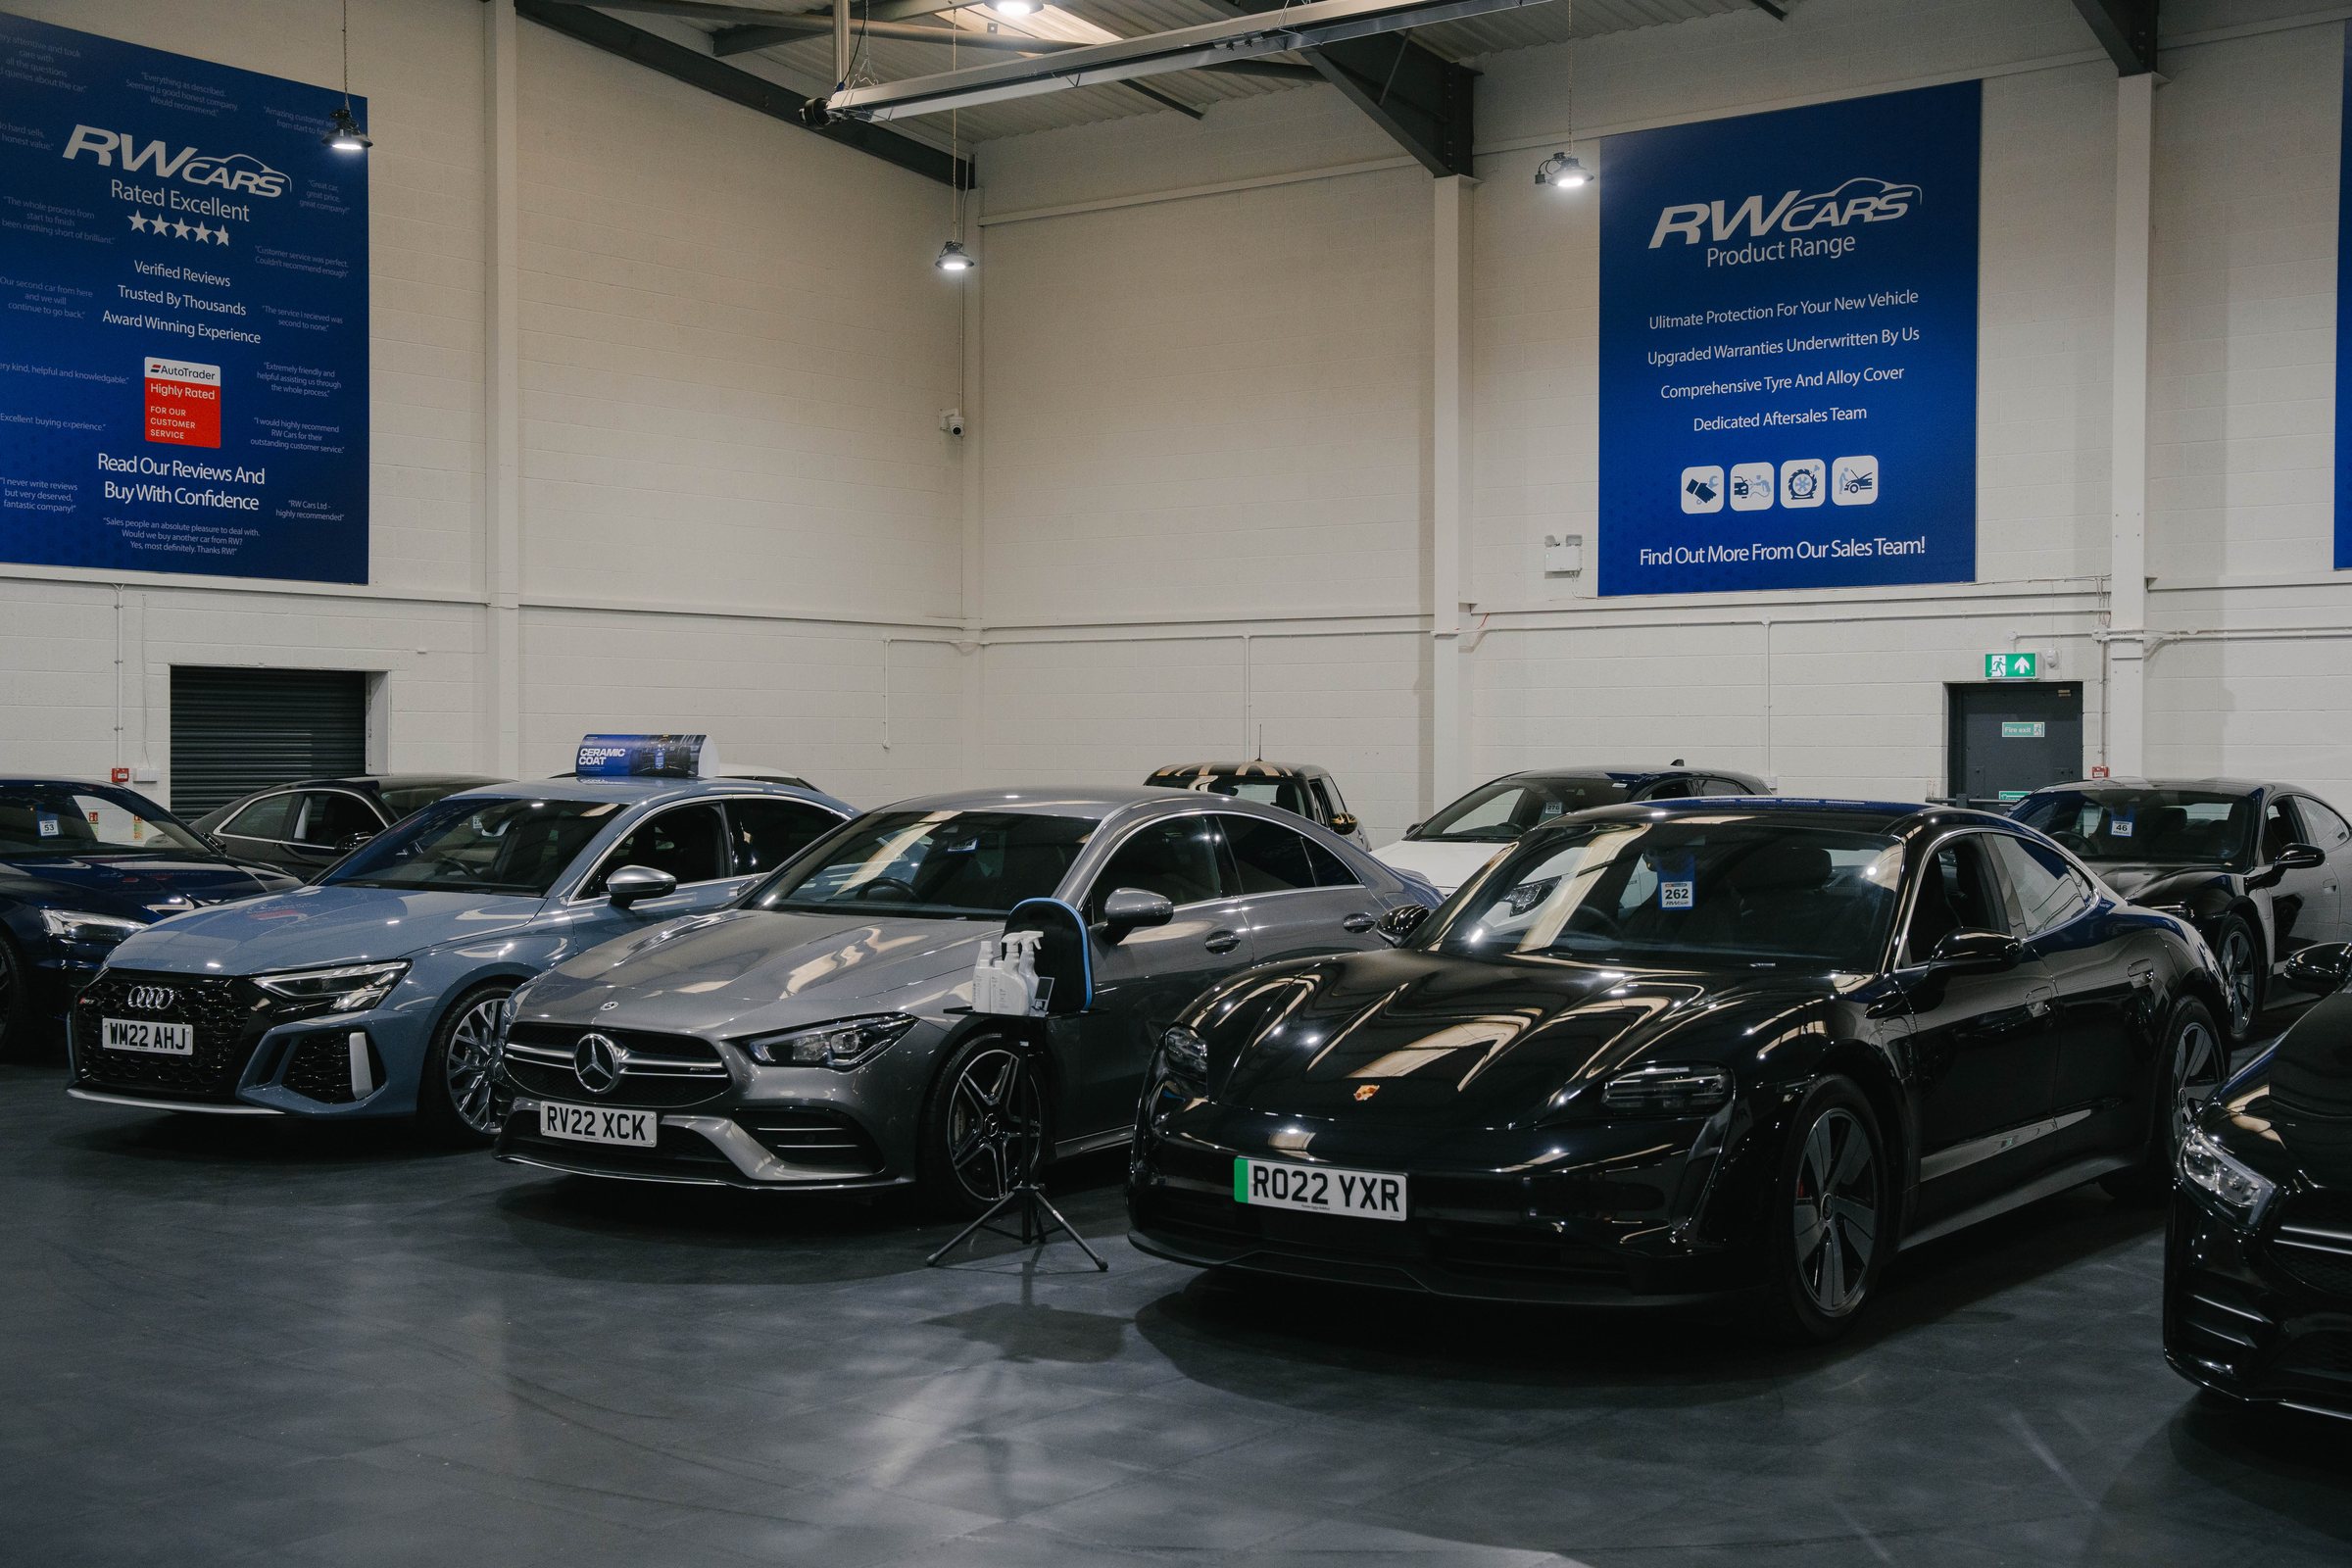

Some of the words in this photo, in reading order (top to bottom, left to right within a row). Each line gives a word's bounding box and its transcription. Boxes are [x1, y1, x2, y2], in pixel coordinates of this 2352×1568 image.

[111, 178, 166, 208] Rated
[171, 190, 250, 222] Excellent
[1707, 240, 1785, 268] Product
[1790, 235, 1856, 259] Range
[134, 260, 180, 279] Verified
[183, 269, 231, 287] Reviews
[54, 296, 67, 305] will
[118, 284, 164, 304] Trusted
[167, 291, 181, 310] By
[182, 294, 247, 317] Thousands
[8, 302, 42, 314] continue
[52, 309, 63, 318] go
[1649, 313, 1704, 329] Ulitmate
[1706, 306, 1774, 323] Protection
[1777, 303, 1799, 318] For
[1800, 300, 1832, 315] Your
[1834, 297, 1866, 311] New
[1868, 290, 1919, 308] Vehicle
[103, 310, 143, 328] Award
[144, 315, 195, 338] Winning
[198, 324, 262, 344] Experience
[1647, 344, 1712, 367] Upgraded
[1714, 340, 1783, 359] Warranties
[1786, 331, 1878, 352] Underwritten
[1882, 329, 1899, 346] By
[1901, 326, 1920, 341] Us
[161, 366, 215, 380] AutoTrader
[150, 383, 183, 399] Highly
[184, 387, 215, 400] Rated
[1660, 378, 1762, 400] Comprehensive
[1764, 376, 1792, 393] Tyre
[1794, 371, 1823, 388] And
[1826, 368, 1860, 388] Alloy
[1863, 366, 1905, 382] Cover
[150, 406, 167, 415] FOR
[169, 408, 186, 416] OUR
[1692, 413, 1760, 432] Dedicated
[1762, 409, 1828, 427] Aftersales
[1829, 406, 1867, 422] Team
[0, 413, 33, 424] Excellent
[35, 416, 62, 428] buying
[150, 417, 196, 428] CUSTOMER
[150, 429, 184, 439] SERVICE
[98, 452, 137, 473] Read
[139, 457, 171, 476] Our
[172, 461, 232, 482] Reviews
[234, 466, 266, 485] And
[29, 479, 49, 489] write
[50, 481, 78, 491] reviews
[4, 488, 19, 498] but
[20, 492, 36, 501] very
[105, 481, 135, 505] Buy
[135, 483, 172, 505] With
[173, 487, 260, 511] Confidence
[3, 500, 35, 511] fantastic
[275, 508, 296, 519] highly
[124, 519, 150, 531] people
[161, 521, 191, 532] absolute
[191, 524, 220, 536] pleasure
[228, 526, 244, 536] deal
[121, 529, 146, 539] Would
[158, 532, 172, 544] buy
[172, 534, 200, 544] another
[211, 535, 228, 545] from
[196, 545, 220, 556] Thanks
[1640, 547, 1672, 565] Find
[1674, 546, 1705, 564] Out
[1706, 545, 1749, 563] More
[1751, 543, 1793, 562] From
[1796, 541, 1829, 560] Our
[1830, 538, 1872, 558] Sales
[1873, 535, 1926, 557] Team!
[578, 757, 607, 765] COAT
[580, 748, 626, 758] CERAMIC
[1665, 889, 1689, 900] 262
[110, 1023, 149, 1048] WM22
[153, 1026, 186, 1051] AHJ
[547, 1106, 597, 1137] RV22
[602, 1111, 647, 1142] XCK
[1252, 1164, 1329, 1205] RO22
[1338, 1174, 1399, 1213] YXR
